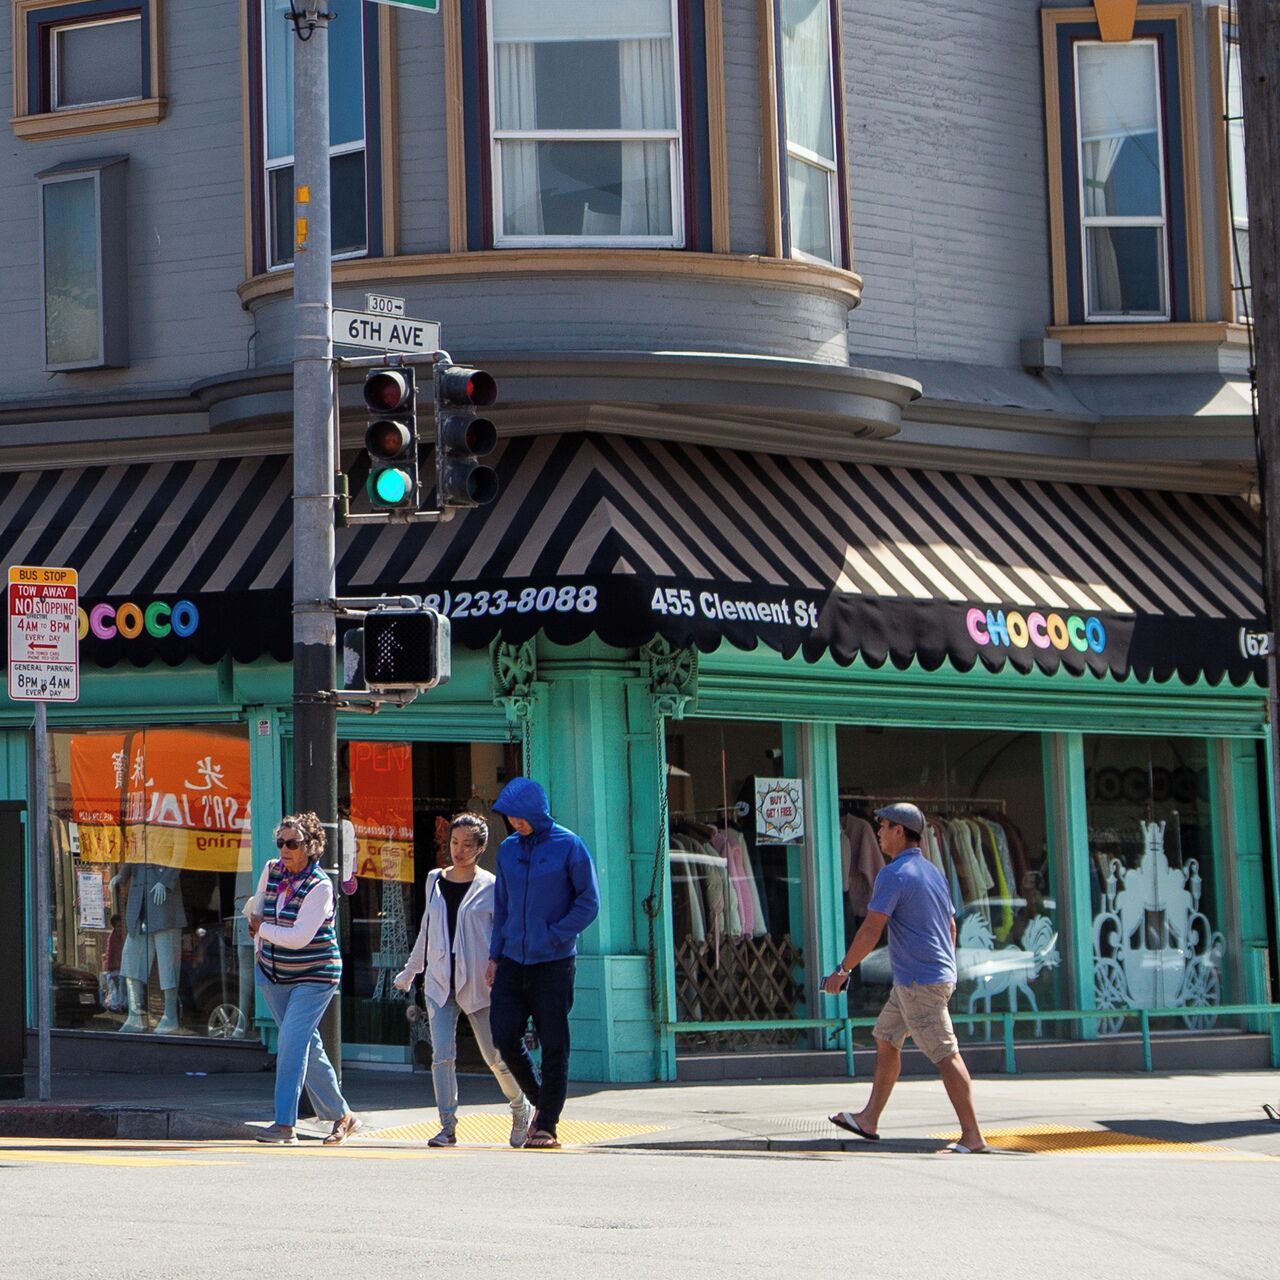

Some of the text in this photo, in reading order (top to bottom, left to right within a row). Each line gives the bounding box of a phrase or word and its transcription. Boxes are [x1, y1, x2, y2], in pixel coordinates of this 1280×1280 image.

[372, 297, 393, 312] 300
[349, 319, 424, 347] 6TH AVE
[19, 570, 67, 582] BUS STOP
[18, 585, 68, 598] TOW AWAY
[15, 598, 74, 616] NO STOPPING
[381, 585, 598, 618] 8)233-8088
[651, 587, 819, 629] 455 Clement St
[77, 600, 200, 641] COCO
[966, 608, 1106, 654] CHOCOCO
[14, 664, 74, 673] GENERAL PARKING
[769, 795, 782, 805] BUY
[765, 808, 776, 818] GET
[780, 807, 792, 817] FREE
